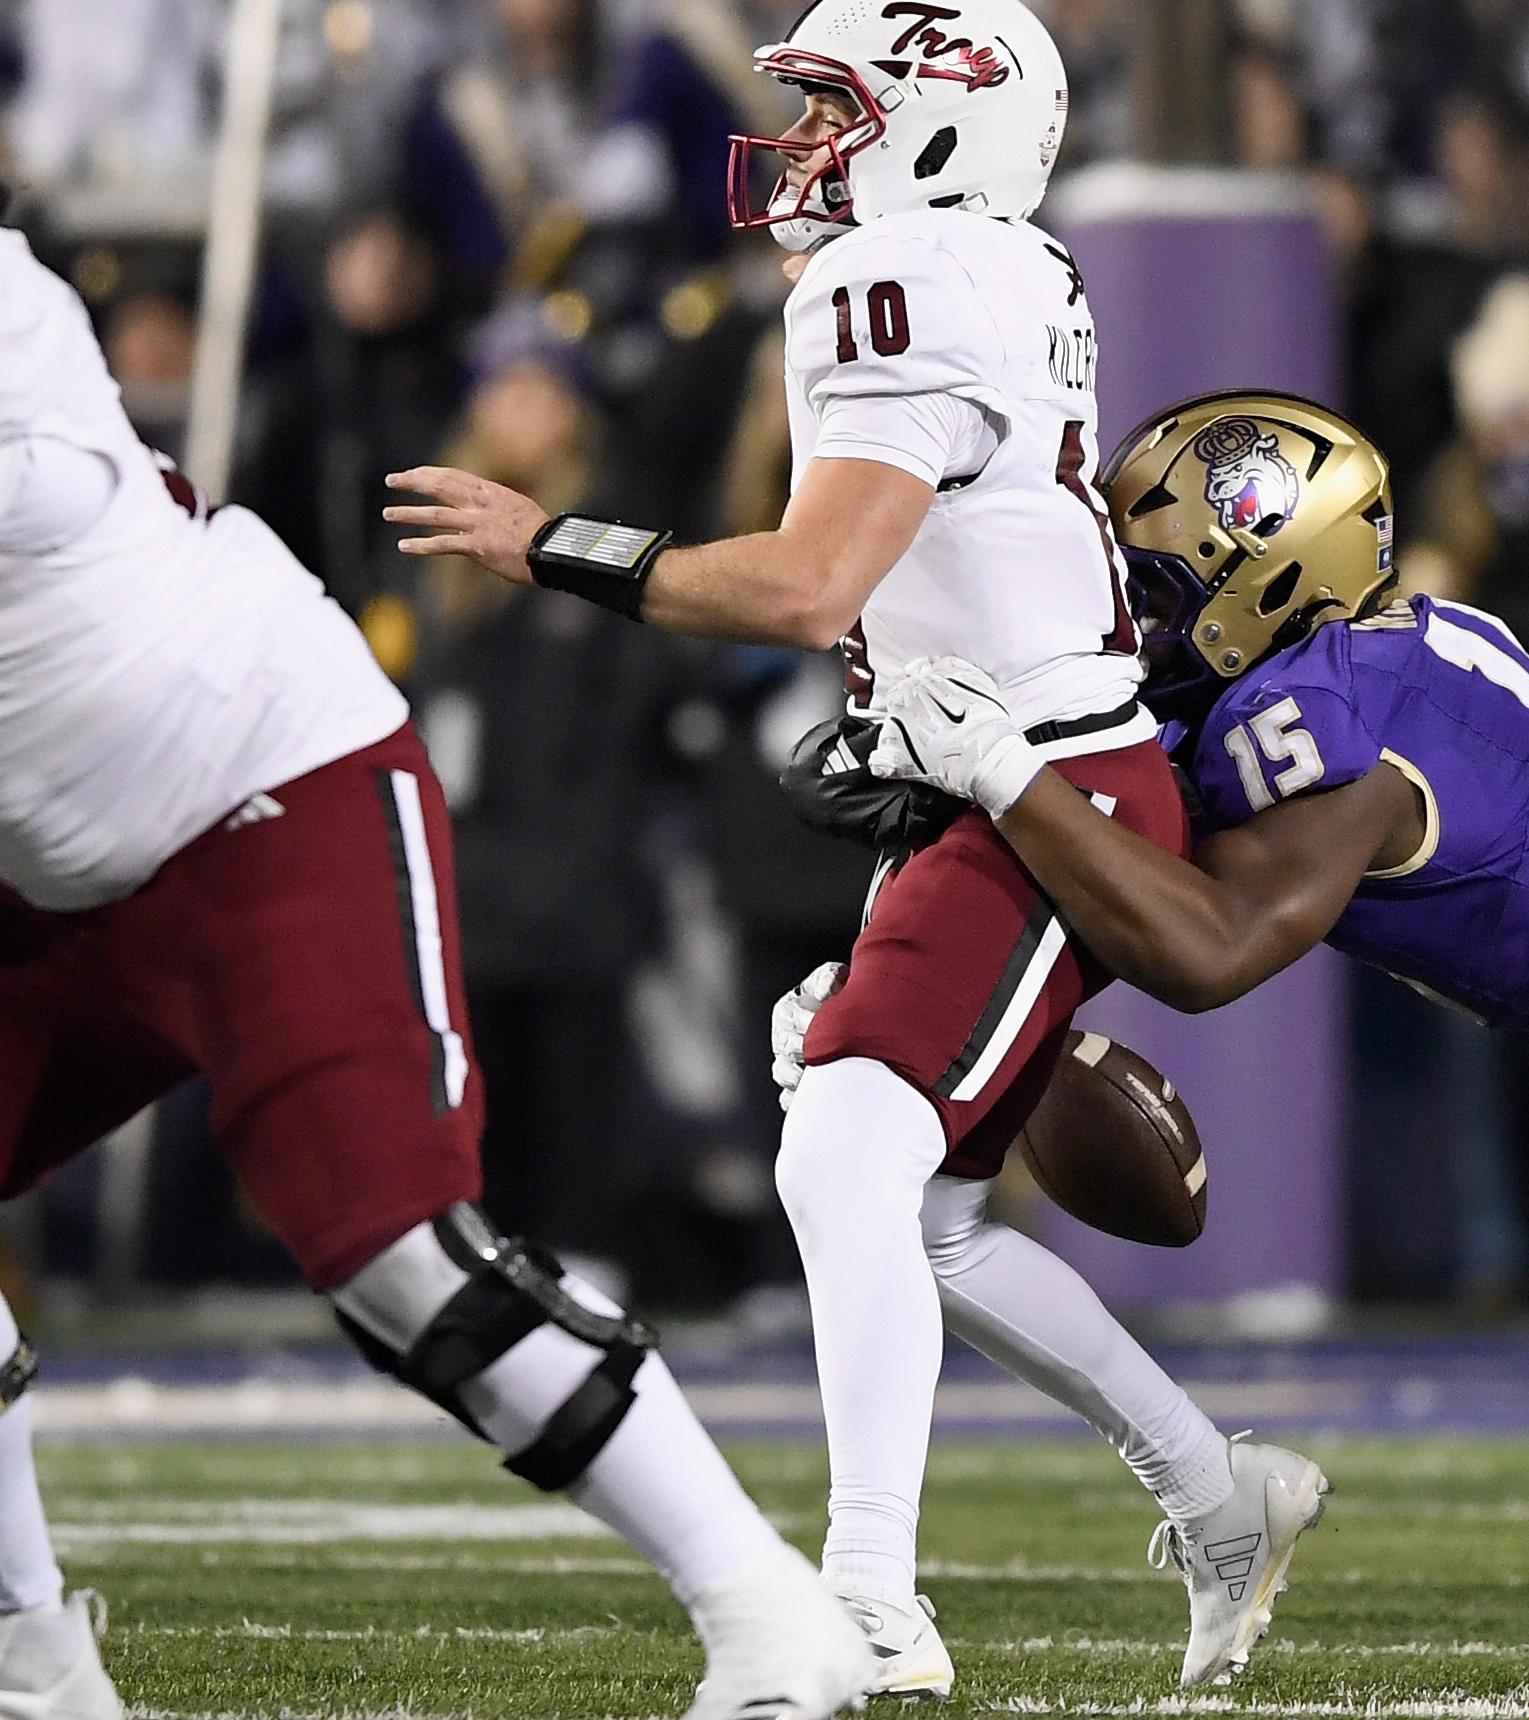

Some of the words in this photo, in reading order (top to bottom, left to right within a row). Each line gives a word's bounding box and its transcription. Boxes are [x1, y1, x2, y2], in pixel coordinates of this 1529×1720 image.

[868, 2, 1011, 93] Troy
[831, 280, 911, 364] 10
[1044, 323, 1095, 392] KILCR
[1223, 696, 1325, 813] 15
